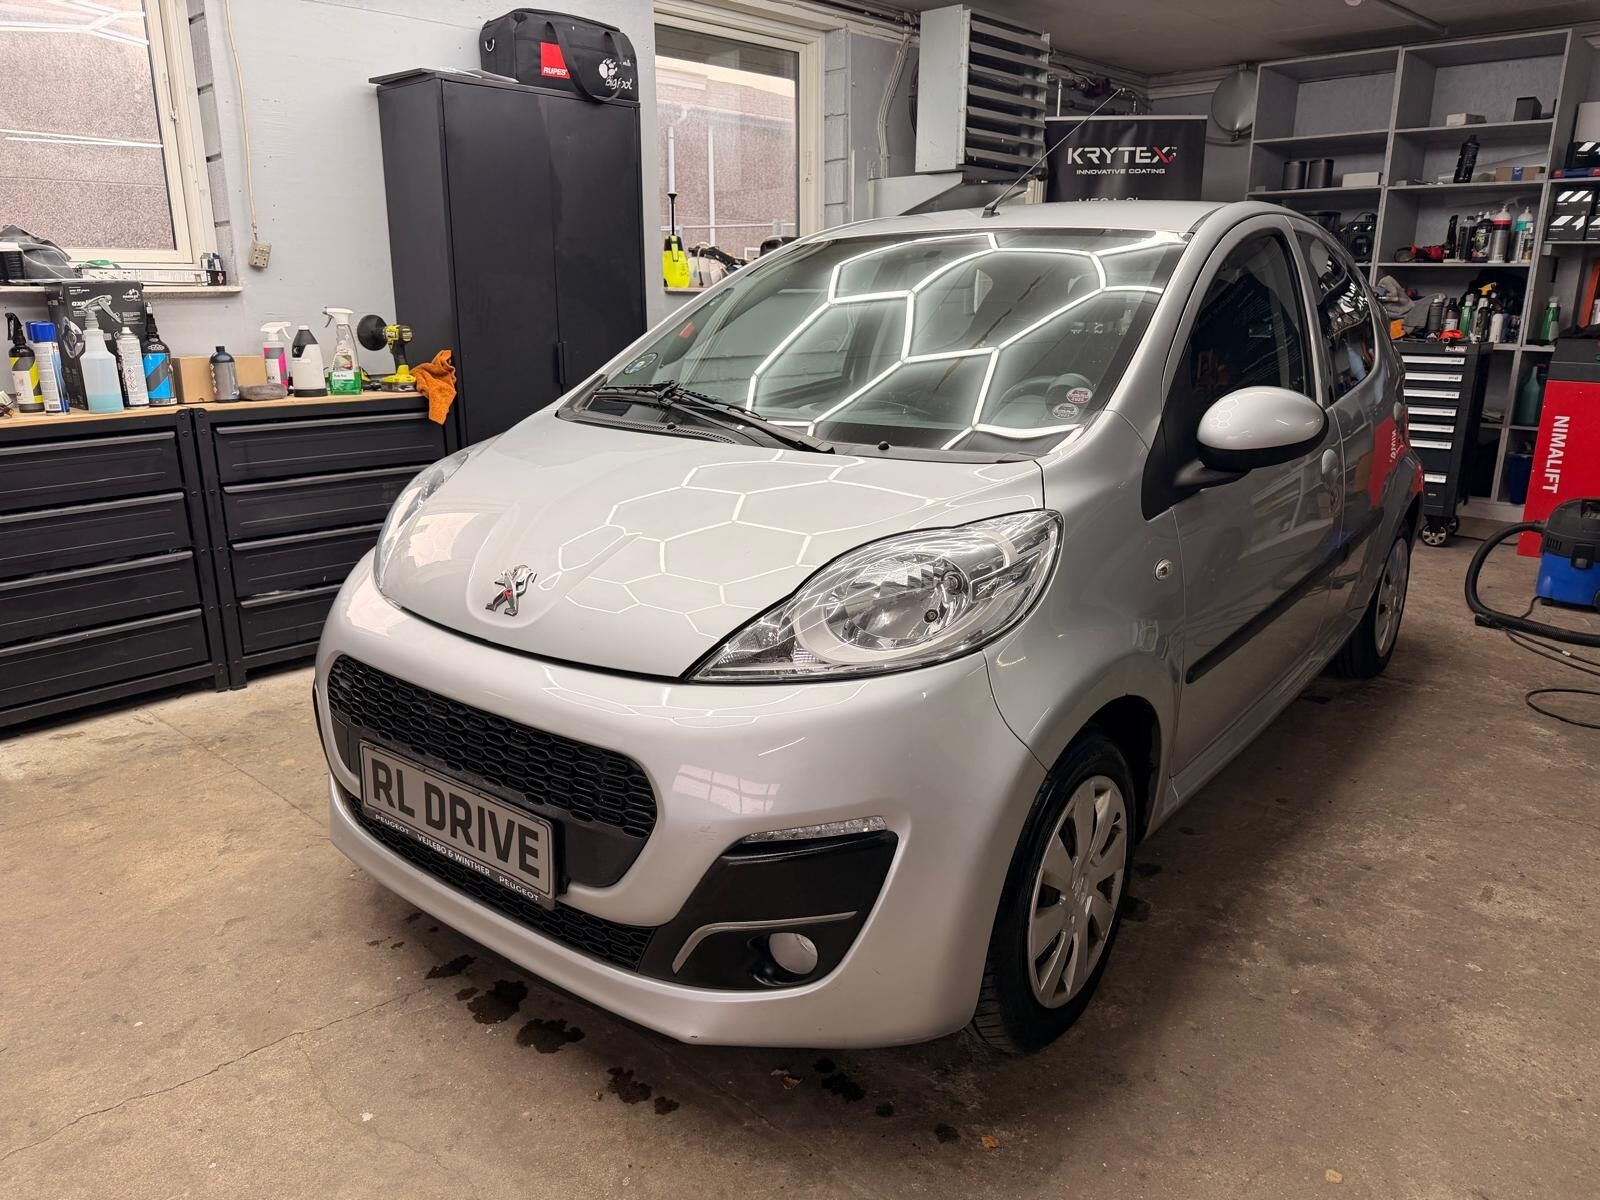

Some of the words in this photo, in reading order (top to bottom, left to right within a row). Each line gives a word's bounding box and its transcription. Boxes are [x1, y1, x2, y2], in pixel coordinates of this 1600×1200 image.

[543, 66, 566, 76] RUPES
[1067, 146, 1171, 164] KRYTEX
[1542, 415, 1570, 493] NIMALIFT
[371, 758, 415, 818] RL
[424, 781, 540, 879] DRIVE
[375, 813, 410, 835] PEUGEOT
[447, 850, 454, 858] &
[454, 852, 491, 876] WINTHER
[498, 874, 539, 902] PEUGEOT
